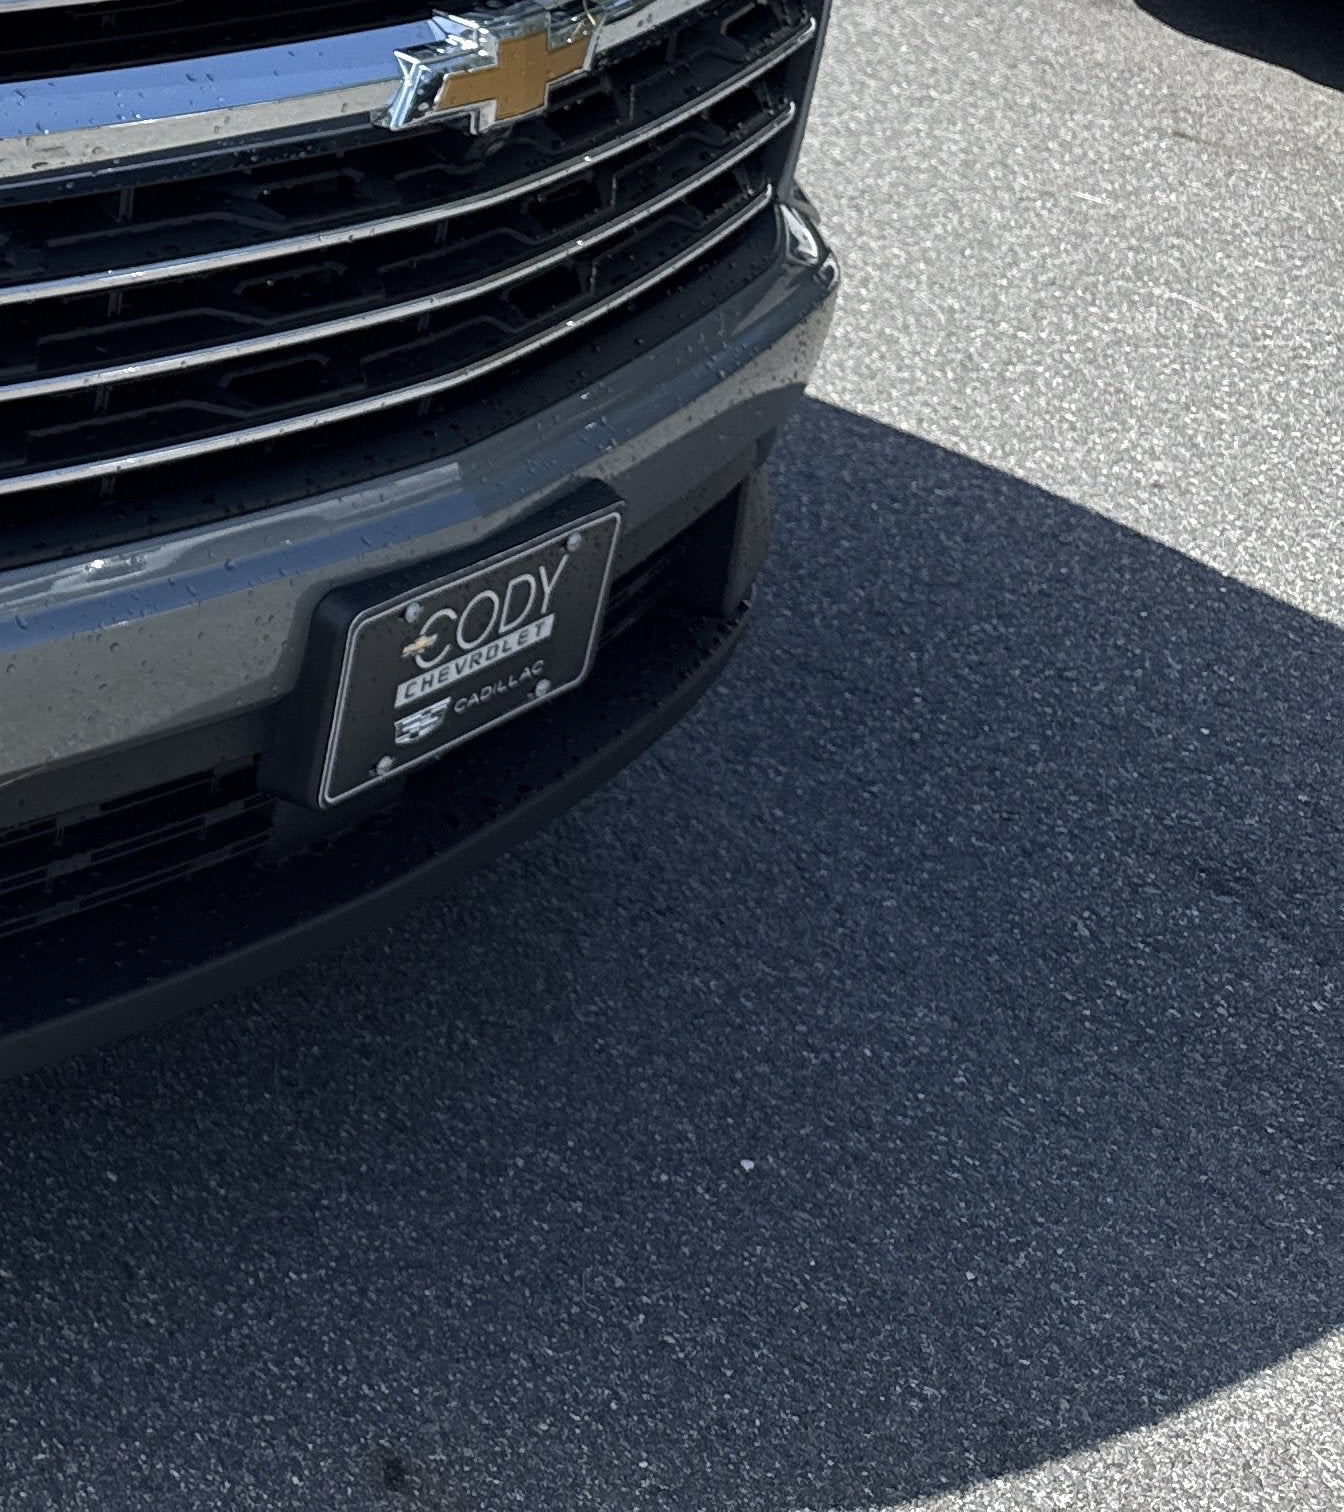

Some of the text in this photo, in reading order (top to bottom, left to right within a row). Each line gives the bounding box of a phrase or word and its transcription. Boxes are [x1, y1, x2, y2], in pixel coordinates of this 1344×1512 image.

[416, 554, 568, 669] CODY
[404, 621, 546, 700] CHEVROLET
[453, 659, 545, 714] CADILLAC
